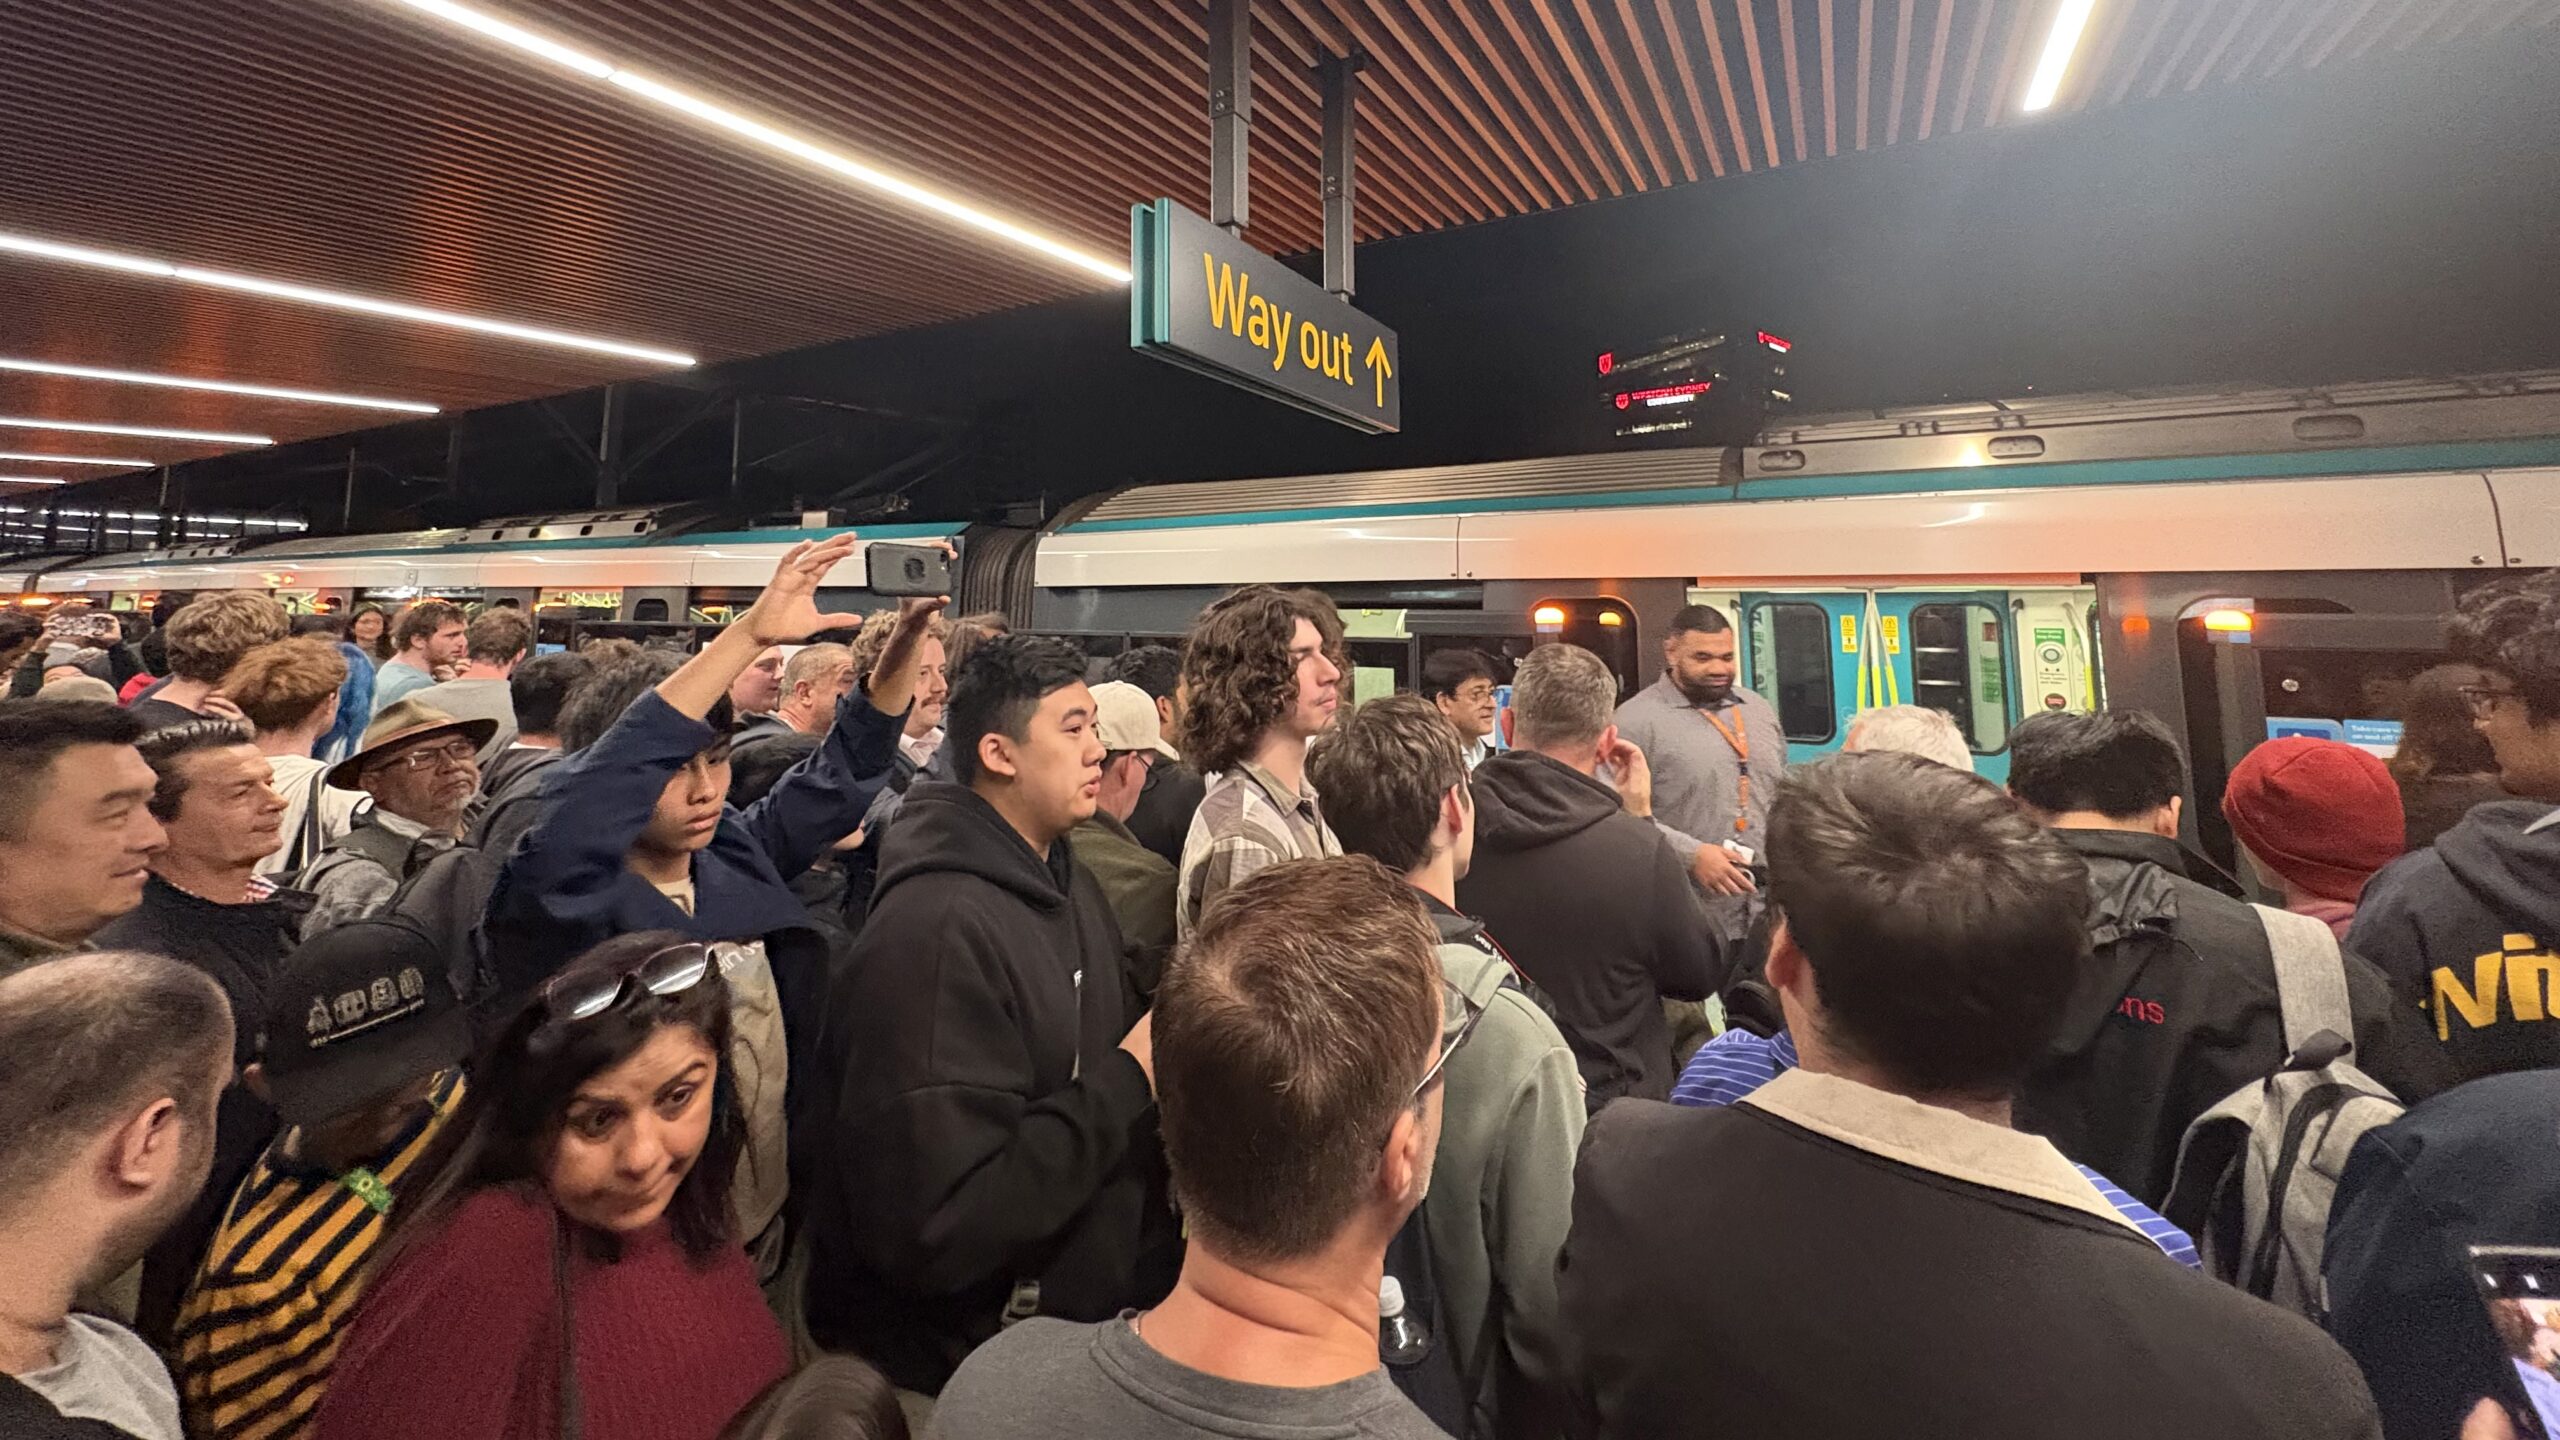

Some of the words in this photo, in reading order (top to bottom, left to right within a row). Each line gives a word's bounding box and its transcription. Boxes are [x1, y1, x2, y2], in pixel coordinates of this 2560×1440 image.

[1204, 252, 1291, 371] Way
[1300, 321, 1353, 385] out
[1674, 382, 1711, 394] SYDNEY
[2117, 997, 2164, 1024] ns
